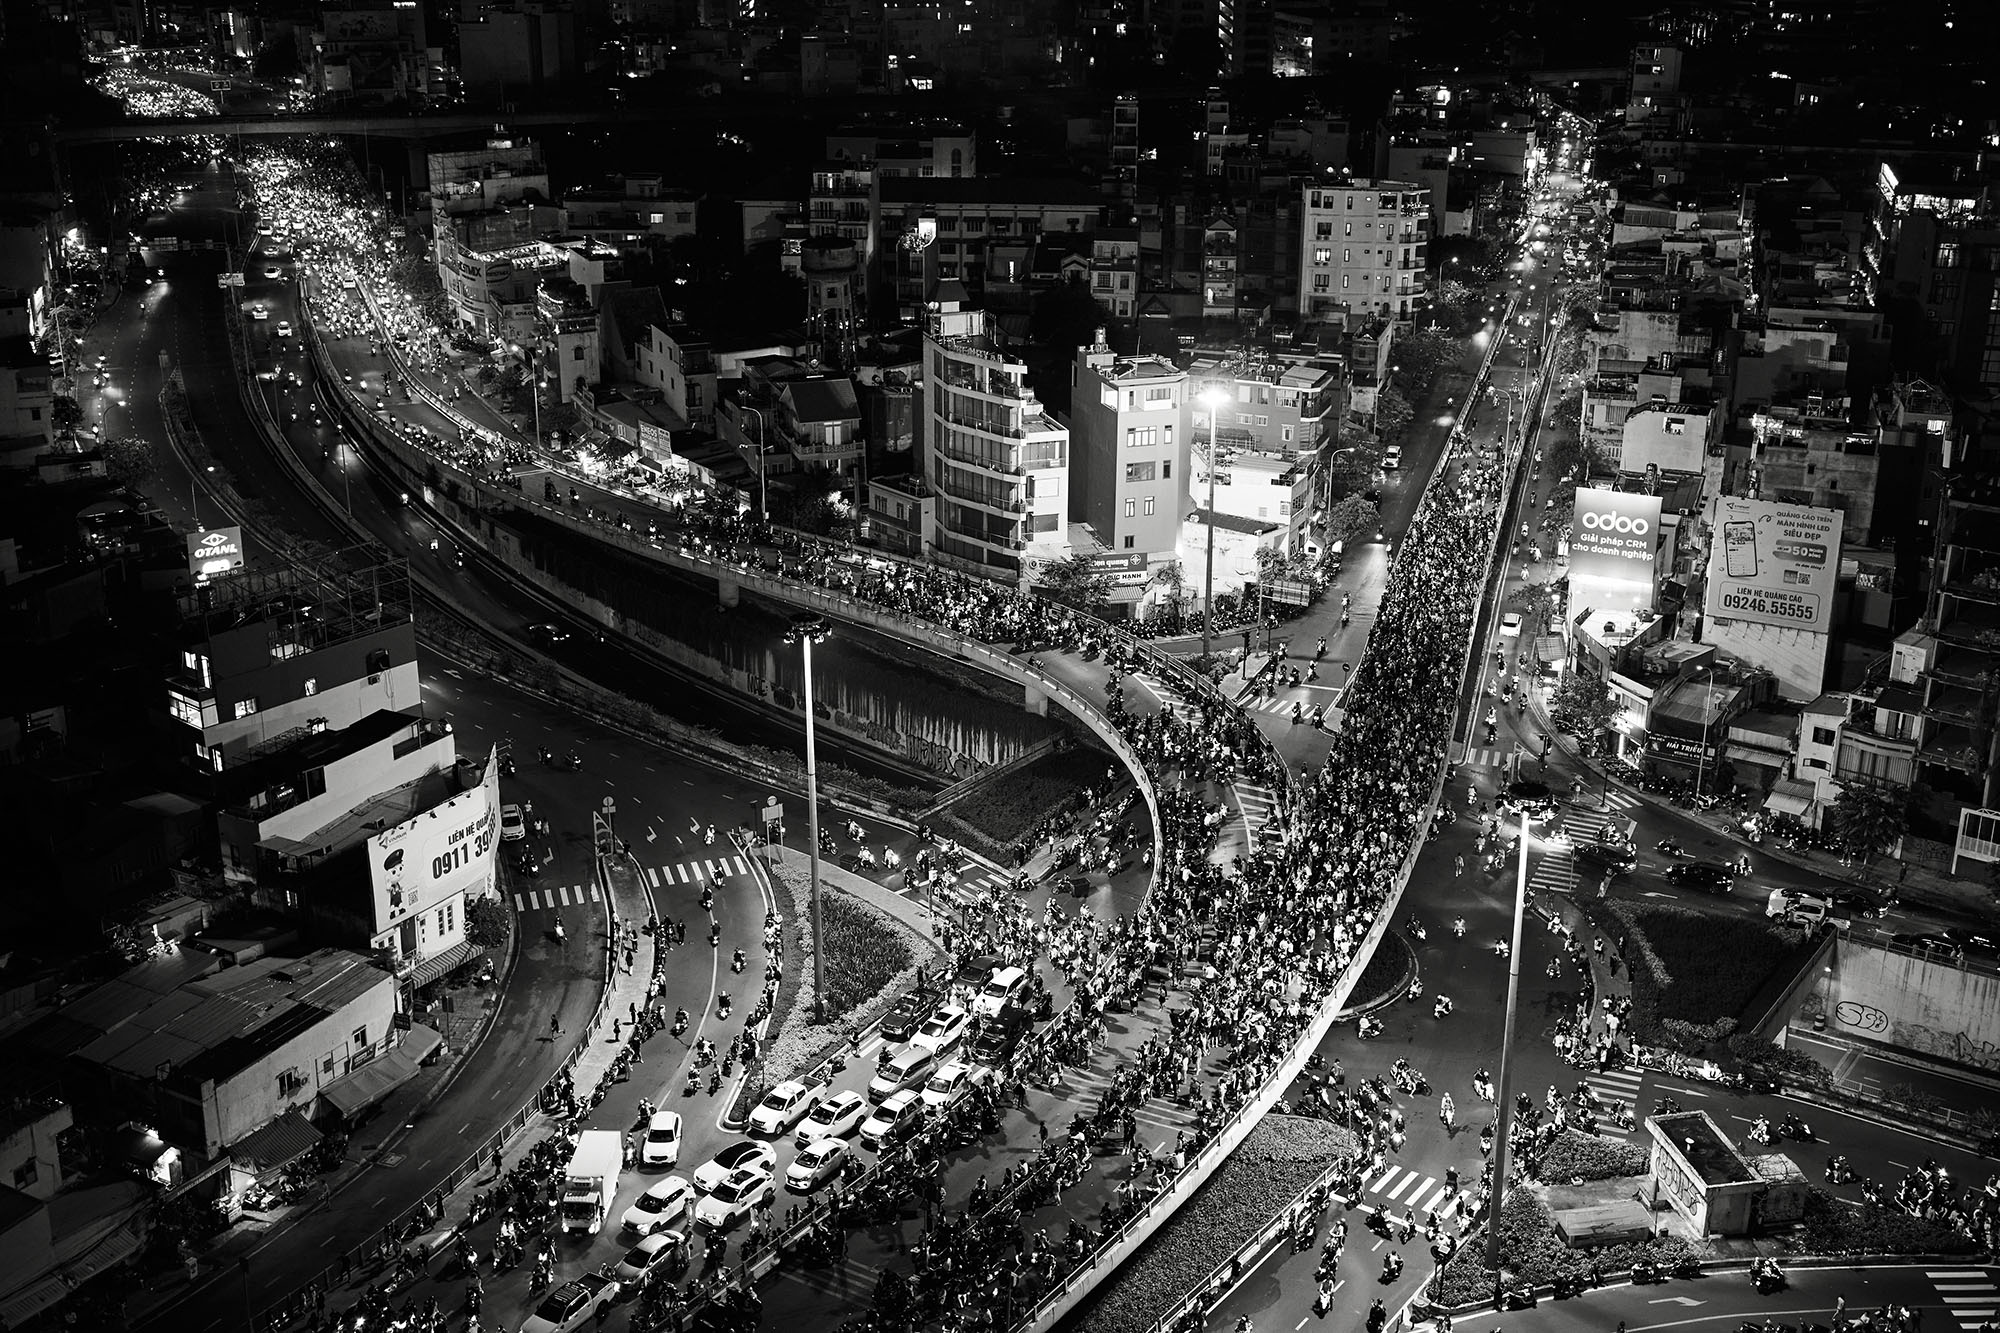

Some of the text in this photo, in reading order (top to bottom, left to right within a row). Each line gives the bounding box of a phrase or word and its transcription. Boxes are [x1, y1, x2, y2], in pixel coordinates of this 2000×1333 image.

[1582, 510, 1649, 535] odoo
[1580, 533, 1647, 549] Giải pháp CRM
[1783, 529, 1821, 541] SIÊU ĐẸP
[1572, 542, 1654, 561] cho doanh nghiệp
[1737, 587, 1803, 603] LIÊN HỆ QUẢNG CÁO
[1723, 594, 1813, 620] 09246.55555
[447, 829, 465, 846] LIÊN
[465, 821, 475, 837] HỆ
[432, 843, 469, 880] 0911
